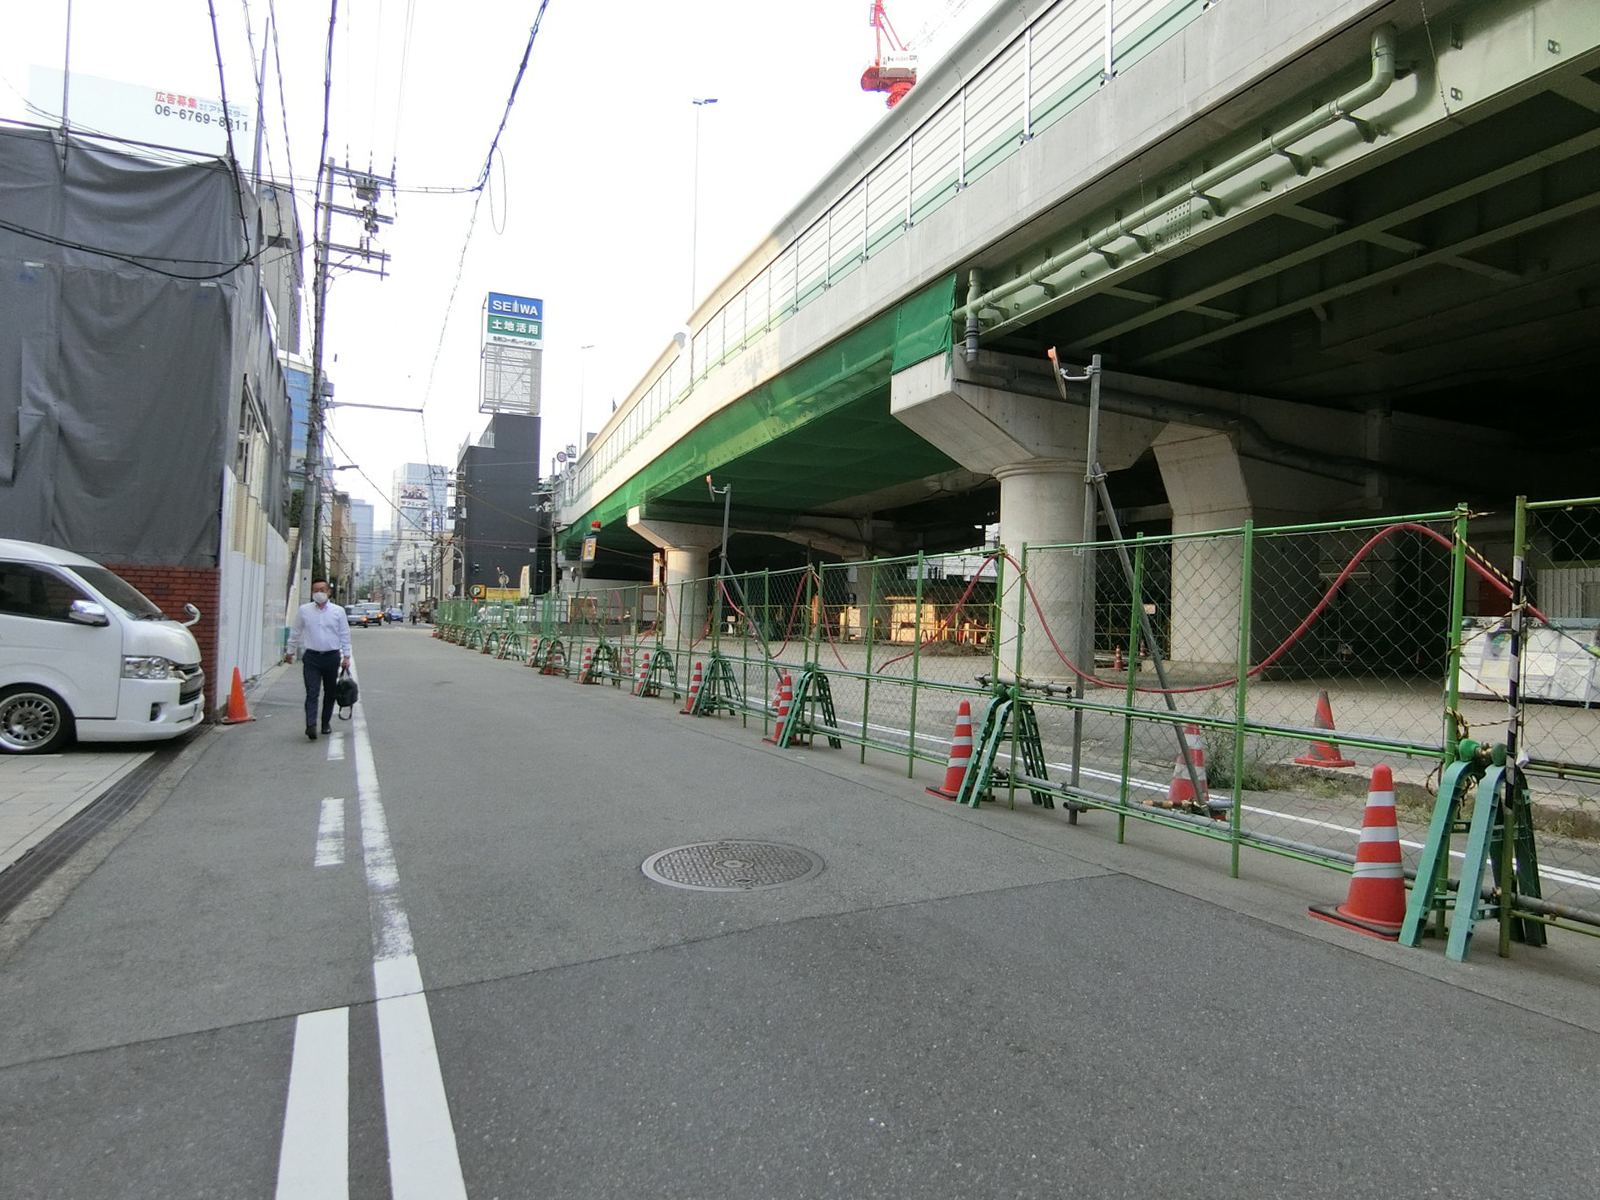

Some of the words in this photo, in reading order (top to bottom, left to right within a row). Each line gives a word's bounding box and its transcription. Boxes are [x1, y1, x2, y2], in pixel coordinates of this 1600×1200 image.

[155, 91, 197, 109] 広告募集
[491, 319, 538, 335] 土地活用
[473, 587, 481, 595] P
